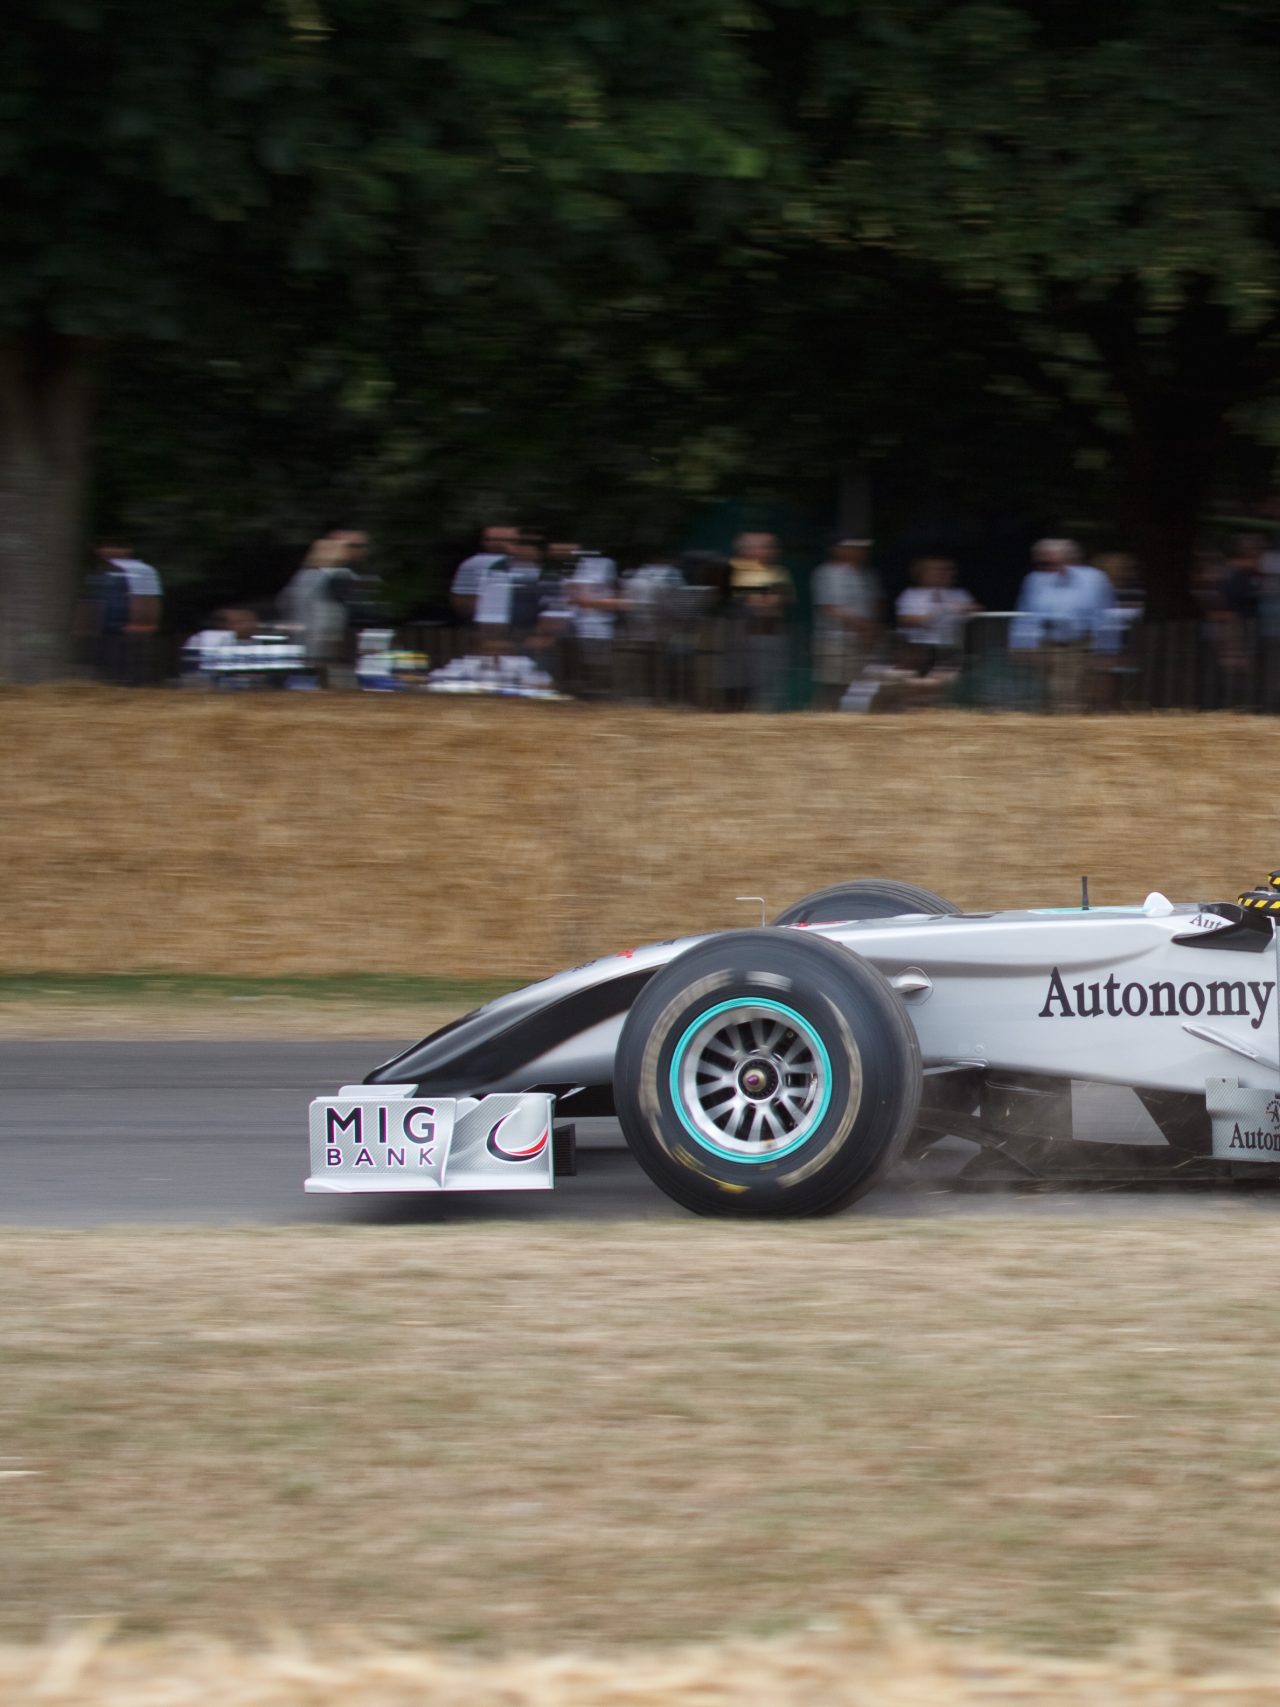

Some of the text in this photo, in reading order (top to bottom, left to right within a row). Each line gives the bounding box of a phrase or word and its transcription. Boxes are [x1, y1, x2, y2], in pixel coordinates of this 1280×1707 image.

[1038, 966, 1276, 1029] Autonomy
[326, 1106, 435, 1144] MIG
[327, 1148, 435, 1167] BANK
